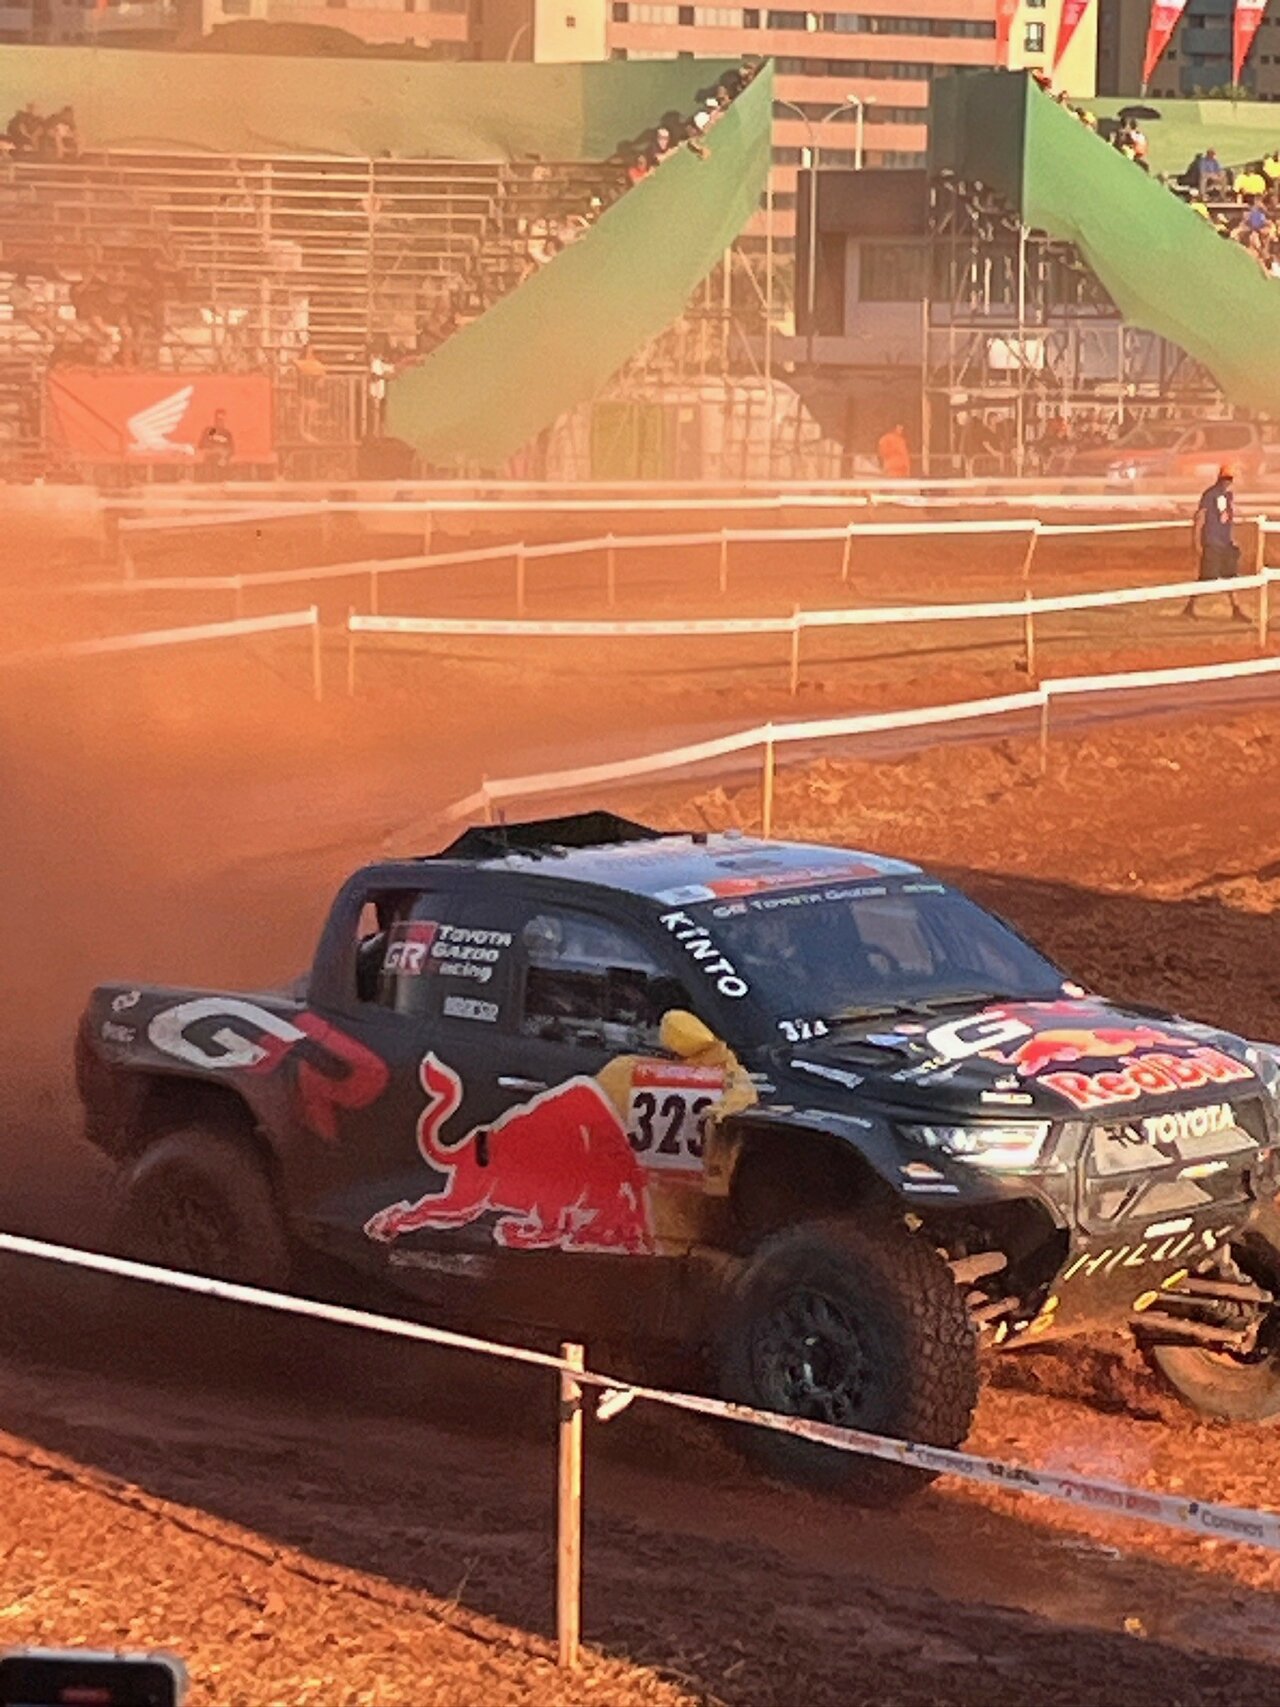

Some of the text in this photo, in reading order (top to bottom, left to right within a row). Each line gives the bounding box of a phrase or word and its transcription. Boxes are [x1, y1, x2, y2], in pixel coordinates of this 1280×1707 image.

[382, 941, 426, 973] GR
[438, 925, 513, 947] TOYOTA
[659, 910, 749, 998] KINTO
[147, 997, 390, 1142] GR
[626, 1091, 713, 1157] 323
[1142, 1102, 1236, 1144] TOYOTA
